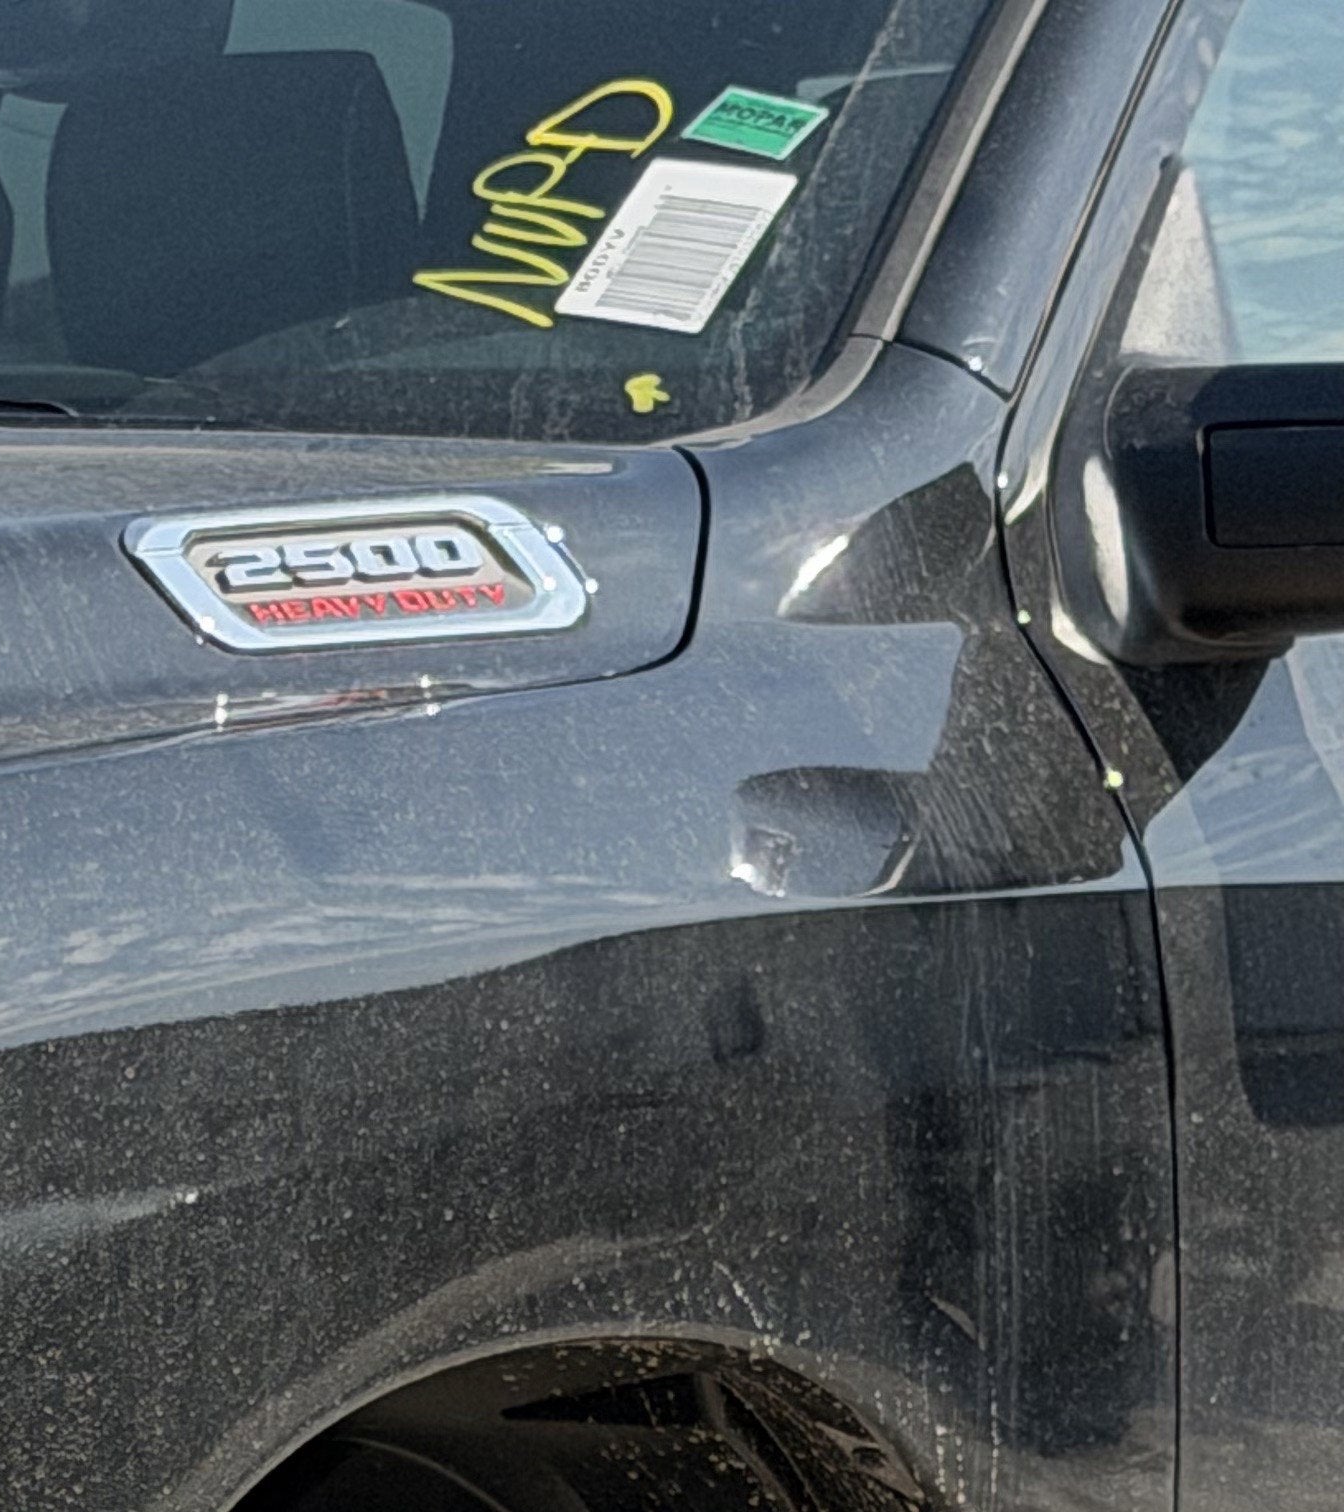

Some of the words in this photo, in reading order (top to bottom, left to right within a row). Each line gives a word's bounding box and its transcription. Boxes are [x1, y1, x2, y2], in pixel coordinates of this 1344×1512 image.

[208, 535, 483, 592] 2500
[248, 592, 385, 626] HEAVY
[390, 583, 505, 613] DUTY
